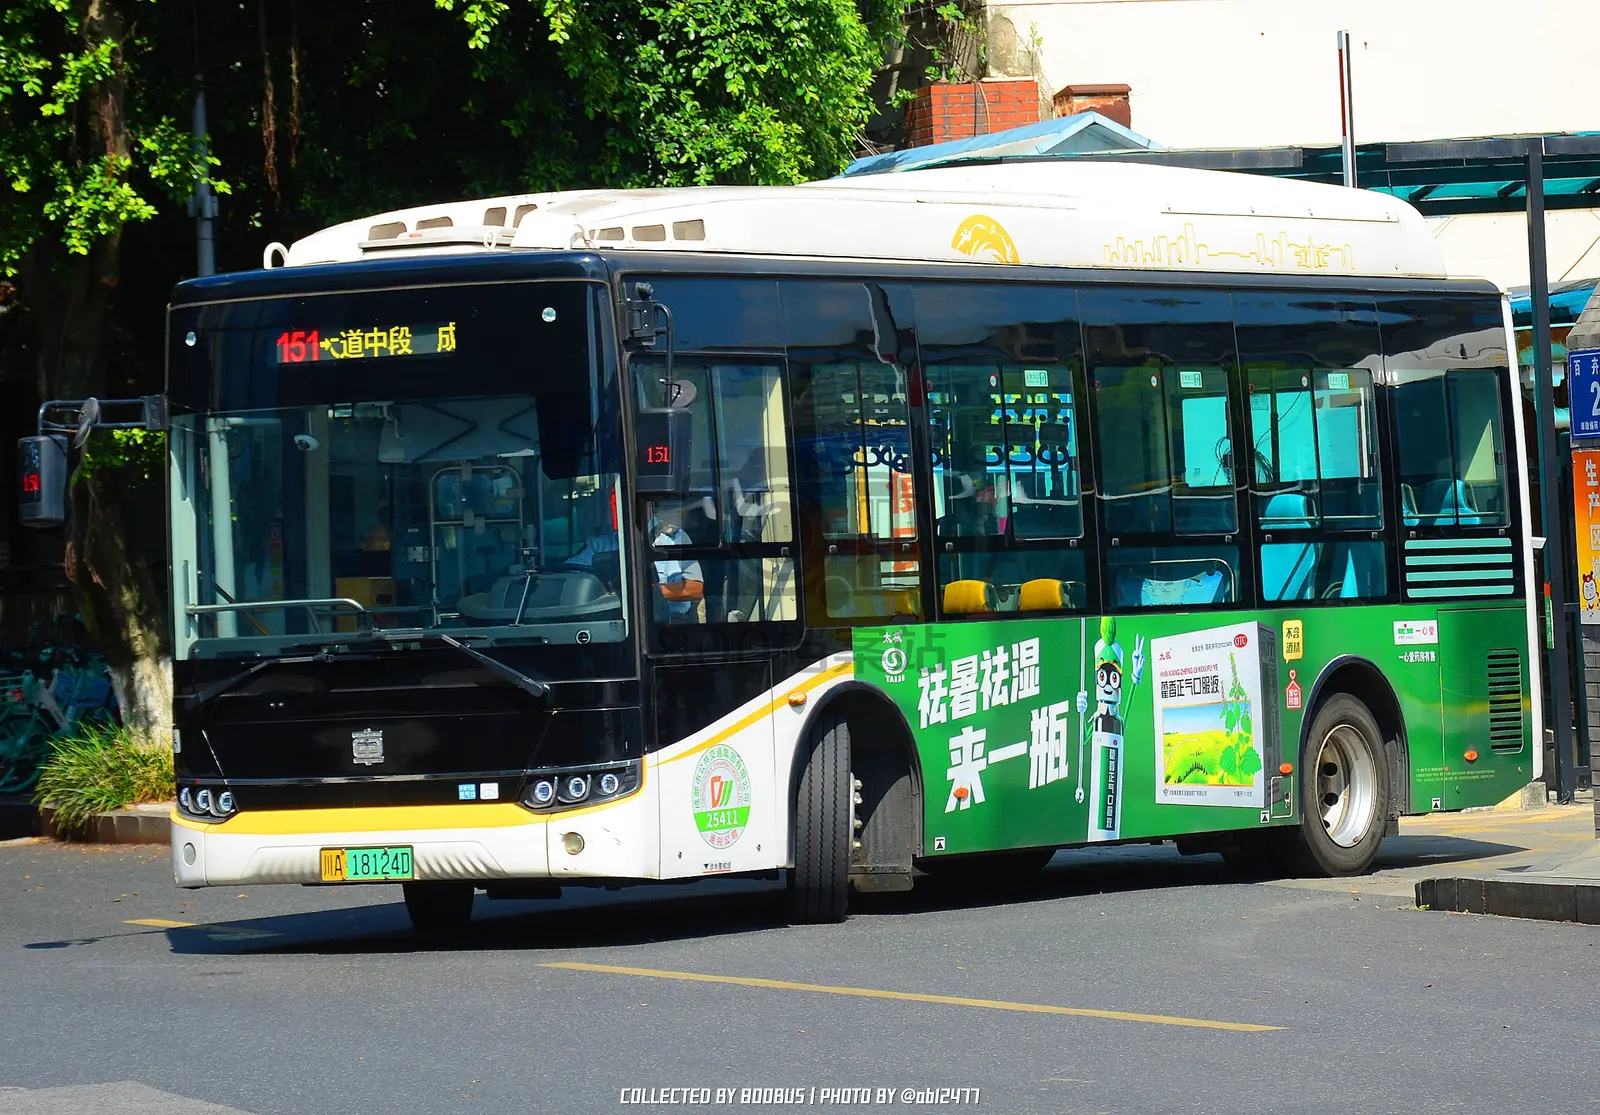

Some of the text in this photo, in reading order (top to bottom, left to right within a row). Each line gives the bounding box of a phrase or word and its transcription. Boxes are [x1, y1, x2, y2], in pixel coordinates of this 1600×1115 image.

[276, 330, 320, 363] 151
[647, 446, 670, 463] 151
[1235, 636, 1247, 646] OTC
[885, 674, 905, 683] TAIJI
[918, 637, 1040, 730] 祛暑祛湿
[1161, 675, 1220, 699] 藿香正气口服液
[944, 700, 1070, 814] 来一瓶
[706, 810, 739, 829] 25411
